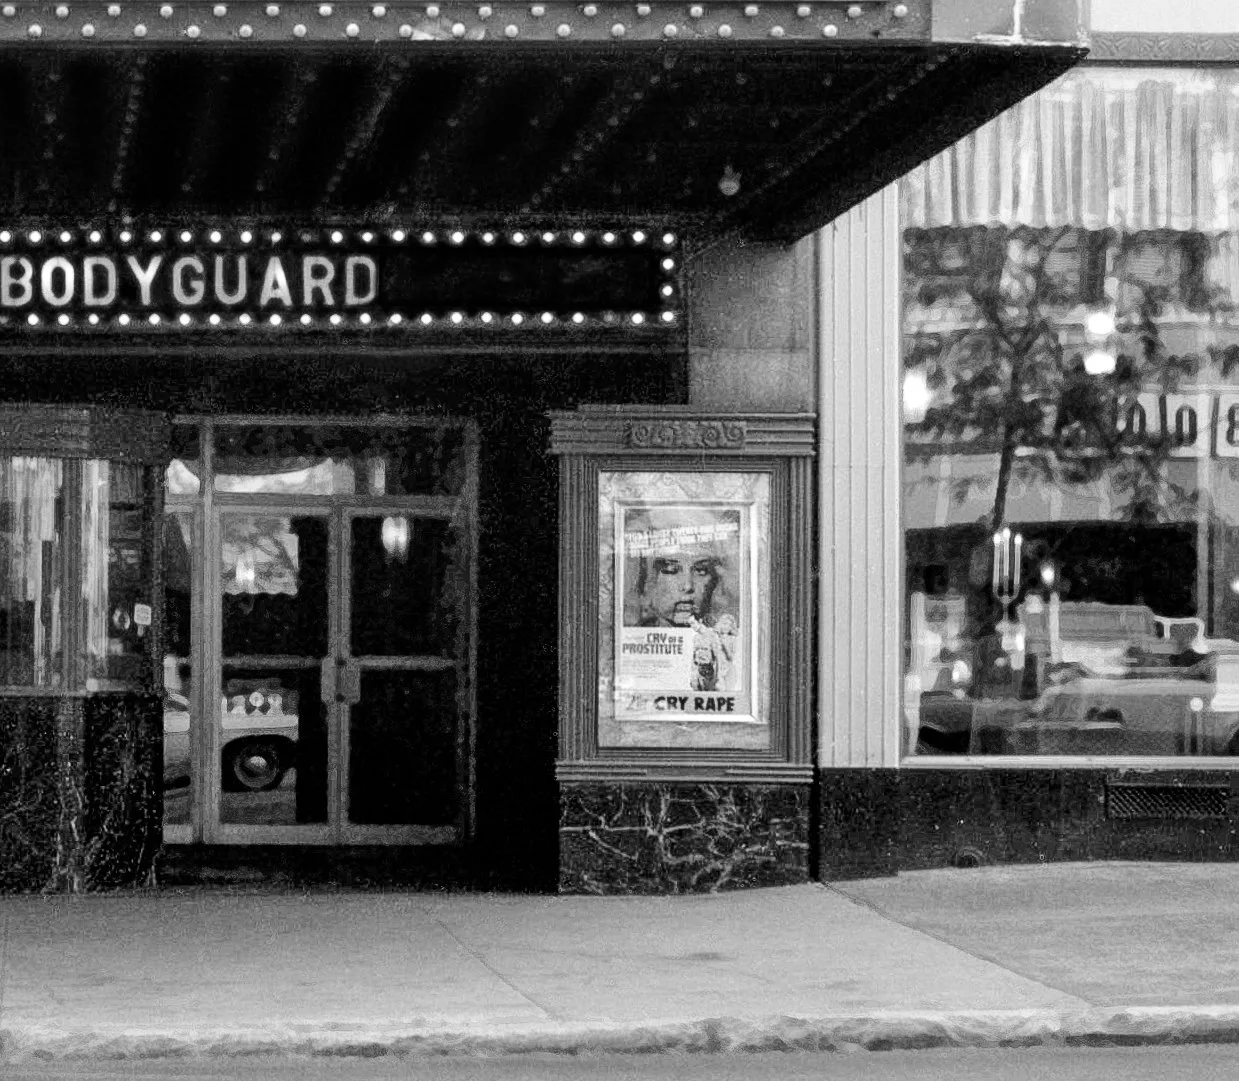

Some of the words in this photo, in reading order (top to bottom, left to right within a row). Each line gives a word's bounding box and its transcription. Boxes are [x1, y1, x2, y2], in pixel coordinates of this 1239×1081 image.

[0, 255, 379, 307] BODYGUARD
[647, 633, 667, 644] CRY
[622, 643, 683, 655] PROSTITUTE
[654, 696, 689, 711] CRY
[694, 696, 735, 712] RAPE
